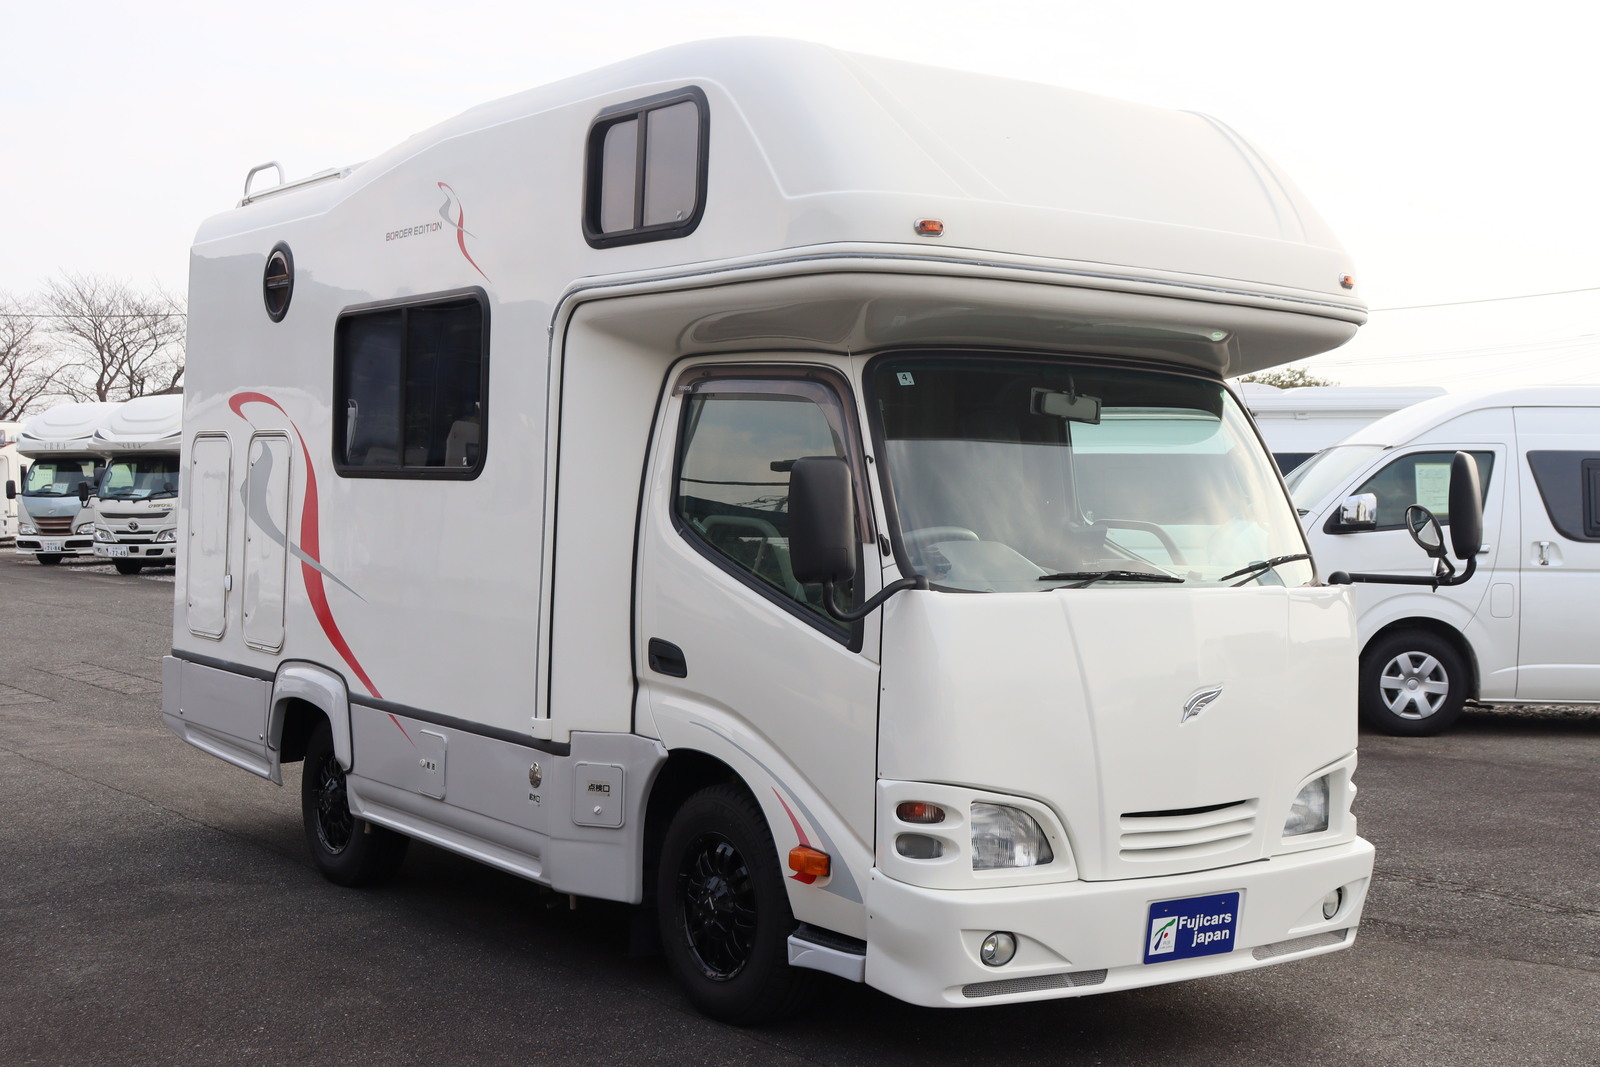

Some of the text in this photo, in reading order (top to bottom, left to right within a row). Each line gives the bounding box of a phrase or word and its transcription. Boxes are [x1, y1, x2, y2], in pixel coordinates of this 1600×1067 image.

[386, 221, 442, 241] BORDER EDITION
[587, 783, 610, 792] 点検口
[1178, 913, 1232, 931] Fujicars
[1191, 929, 1230, 947] japan
